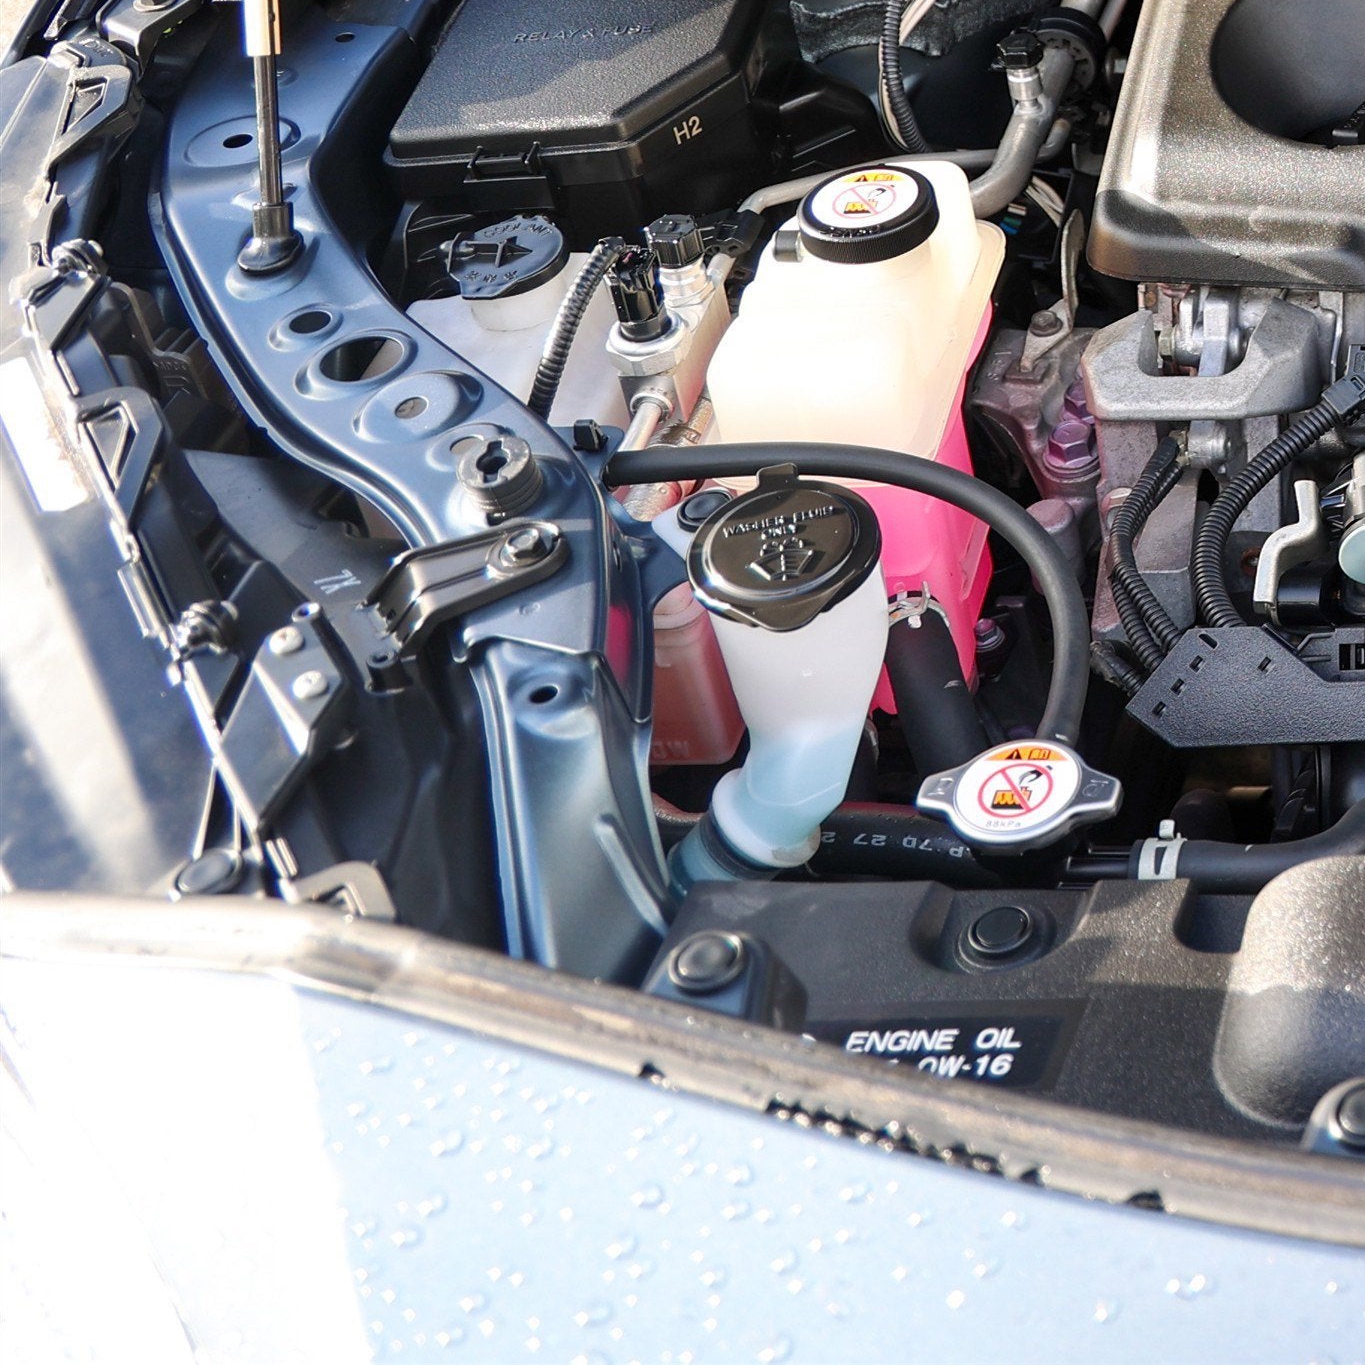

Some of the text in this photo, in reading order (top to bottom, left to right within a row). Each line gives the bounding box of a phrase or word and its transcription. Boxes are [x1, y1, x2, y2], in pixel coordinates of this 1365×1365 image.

[514, 28, 581, 44] RELAY
[602, 23, 654, 37] FUSE
[672, 115, 703, 145] H2
[722, 505, 834, 539] WASHER FLUID
[760, 524, 796, 540] ONLY
[985, 821, 1022, 829] 88kPa
[853, 833, 886, 847] 27
[846, 1026, 1023, 1054] ENGINE OIL
